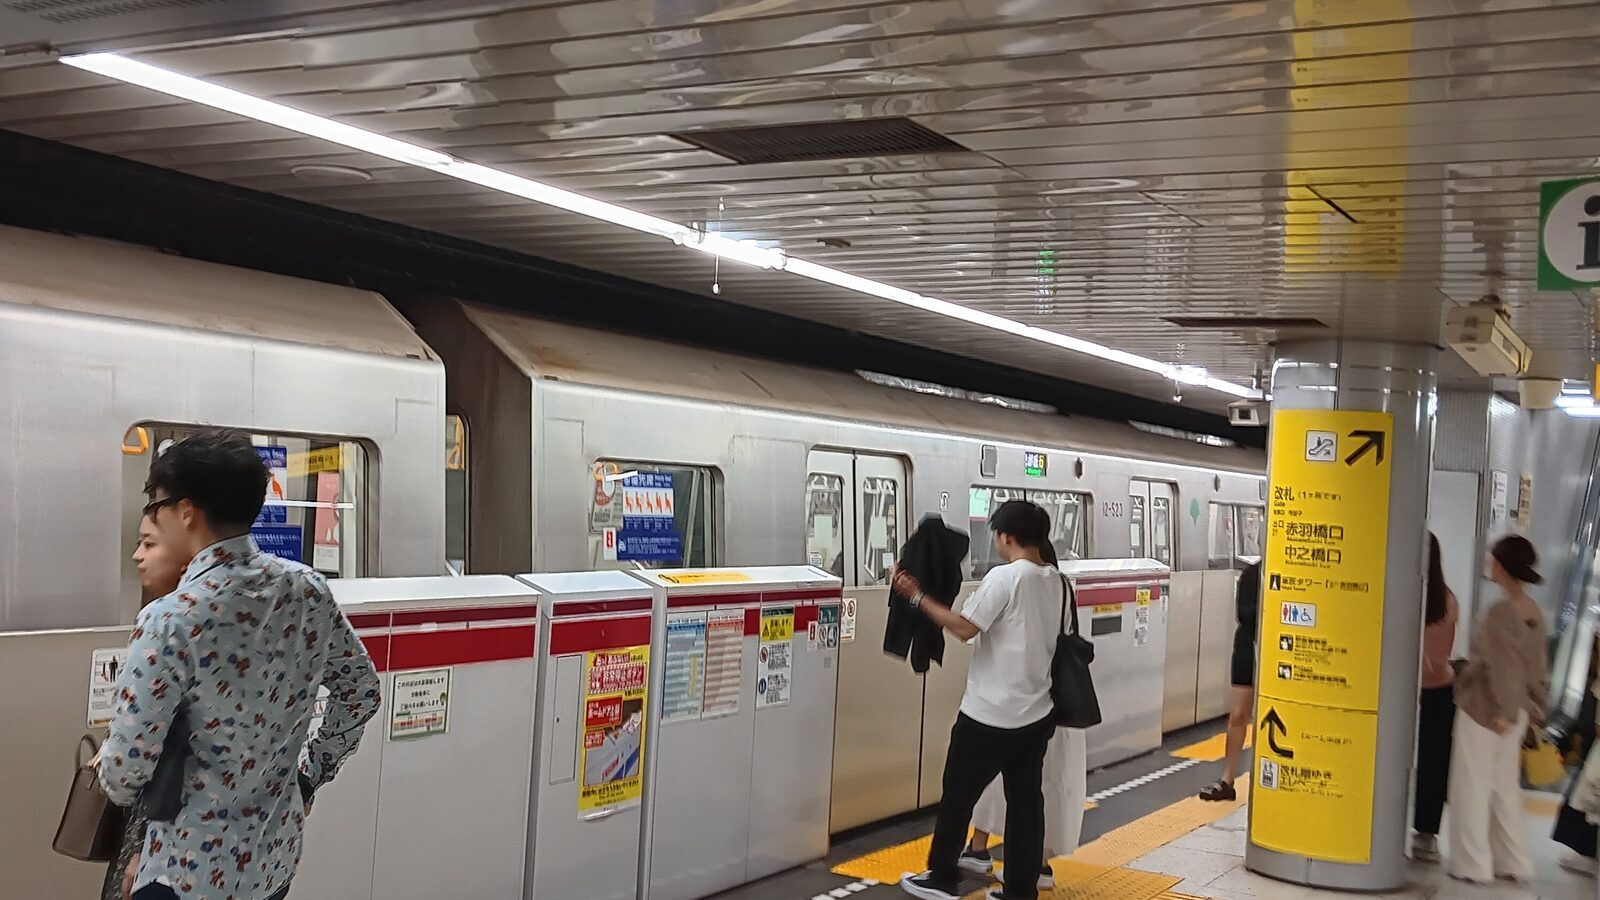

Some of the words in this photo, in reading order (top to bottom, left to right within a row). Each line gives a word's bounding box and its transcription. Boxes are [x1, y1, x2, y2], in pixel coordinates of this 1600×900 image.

[1274, 486, 1295, 501] 改札
[1286, 521, 1344, 541] 赤羽橋口
[1284, 544, 1342, 564] 中之橋口
